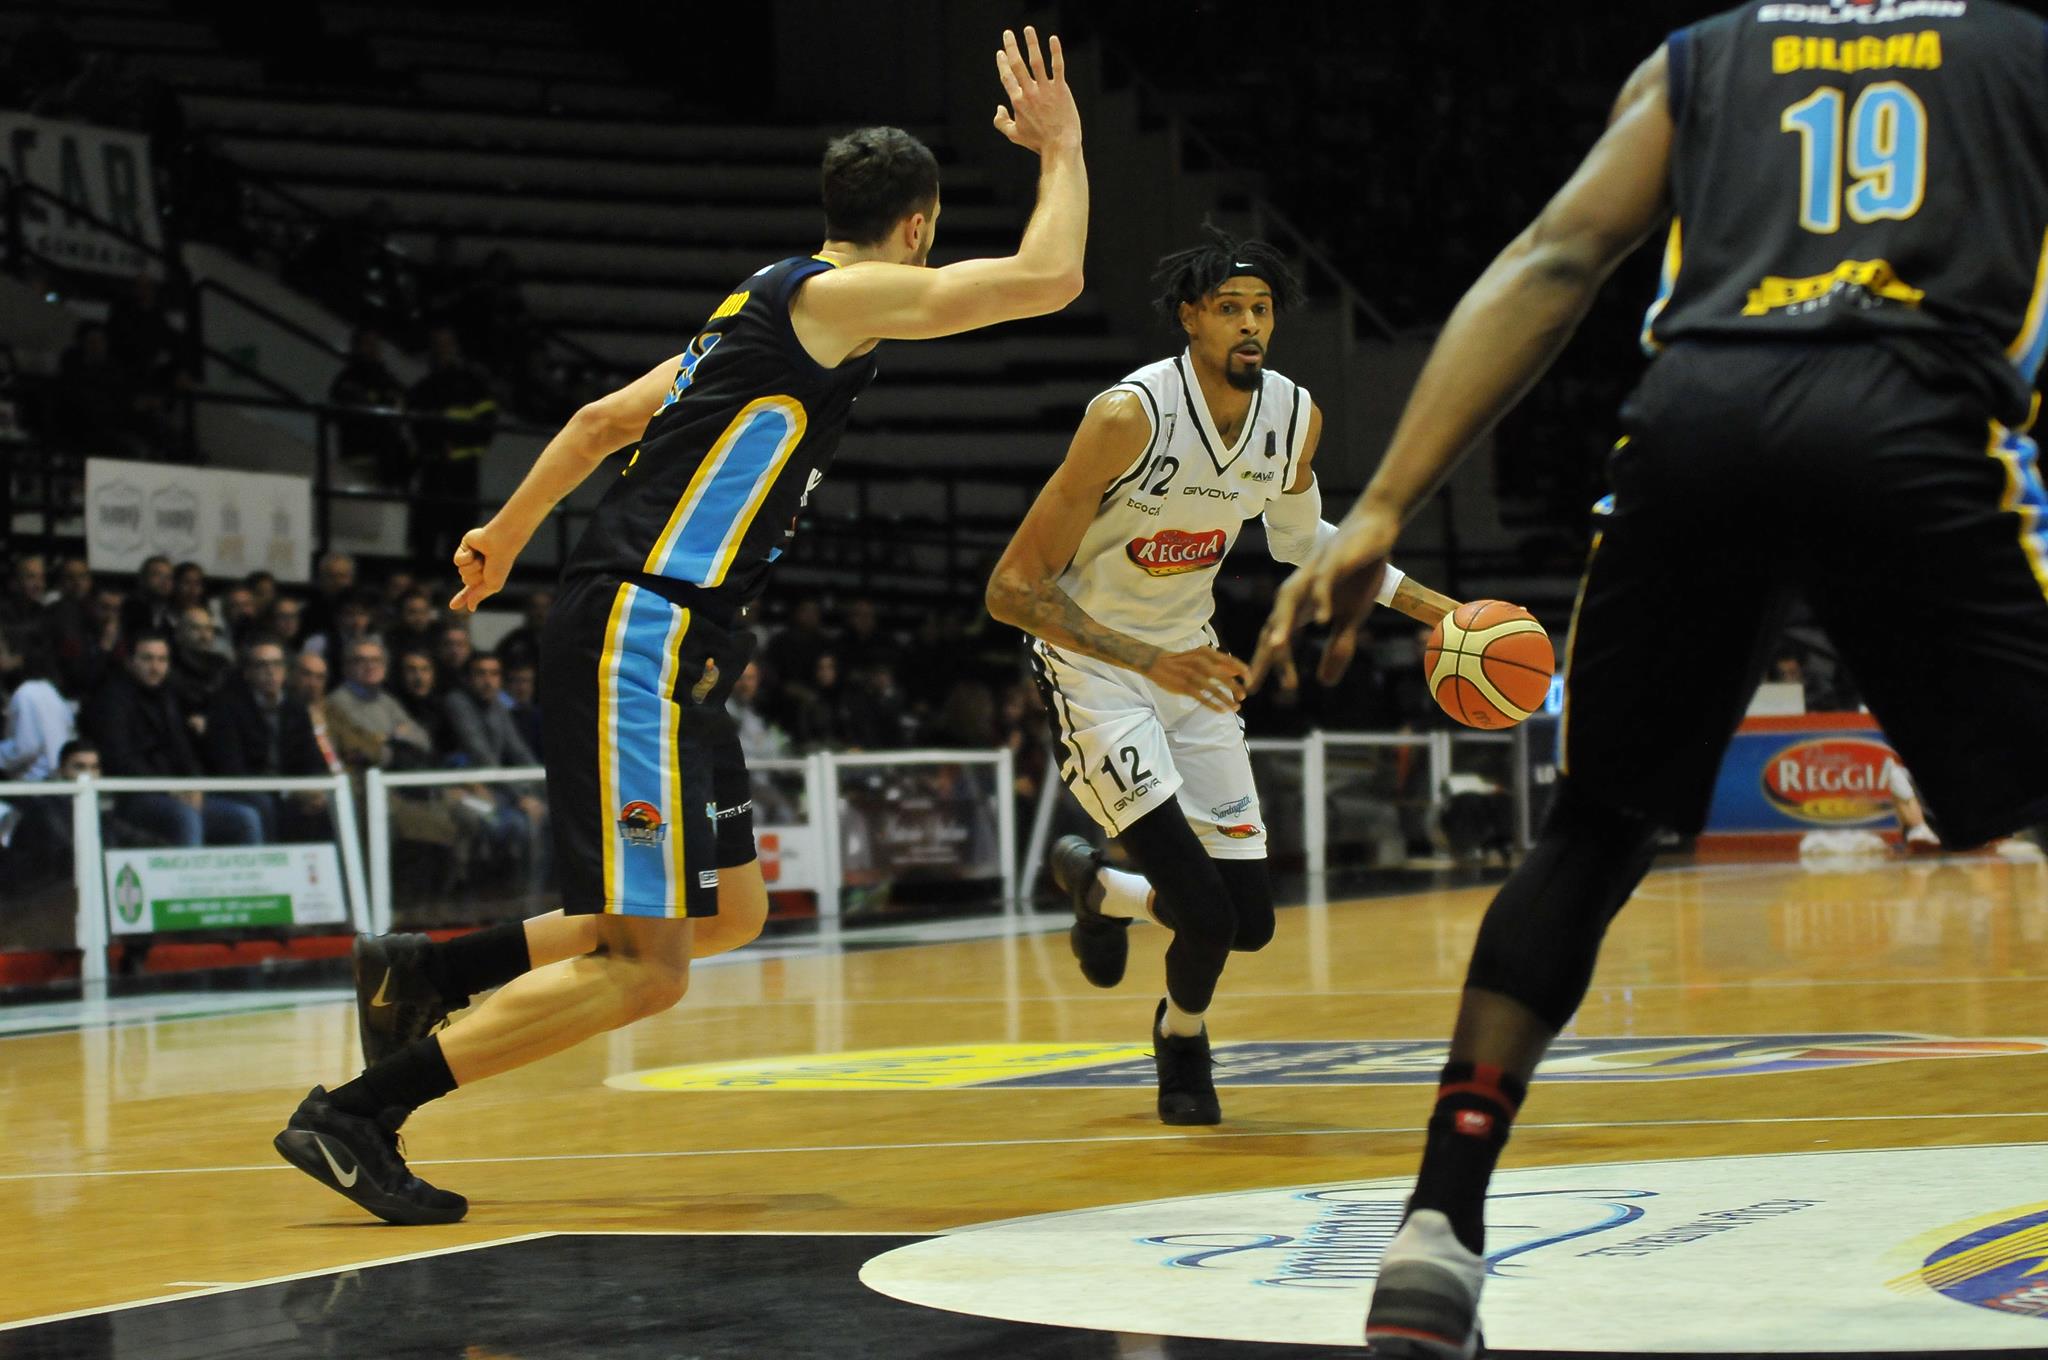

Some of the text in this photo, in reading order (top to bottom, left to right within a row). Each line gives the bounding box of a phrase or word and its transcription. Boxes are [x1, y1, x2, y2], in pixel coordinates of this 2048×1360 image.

[1780, 80, 1928, 235] 19
[1138, 455, 1180, 497] 12
[1137, 534, 1220, 564] REGGIA
[1100, 745, 1153, 793] 12
[1113, 777, 1163, 812] GIVOVA
